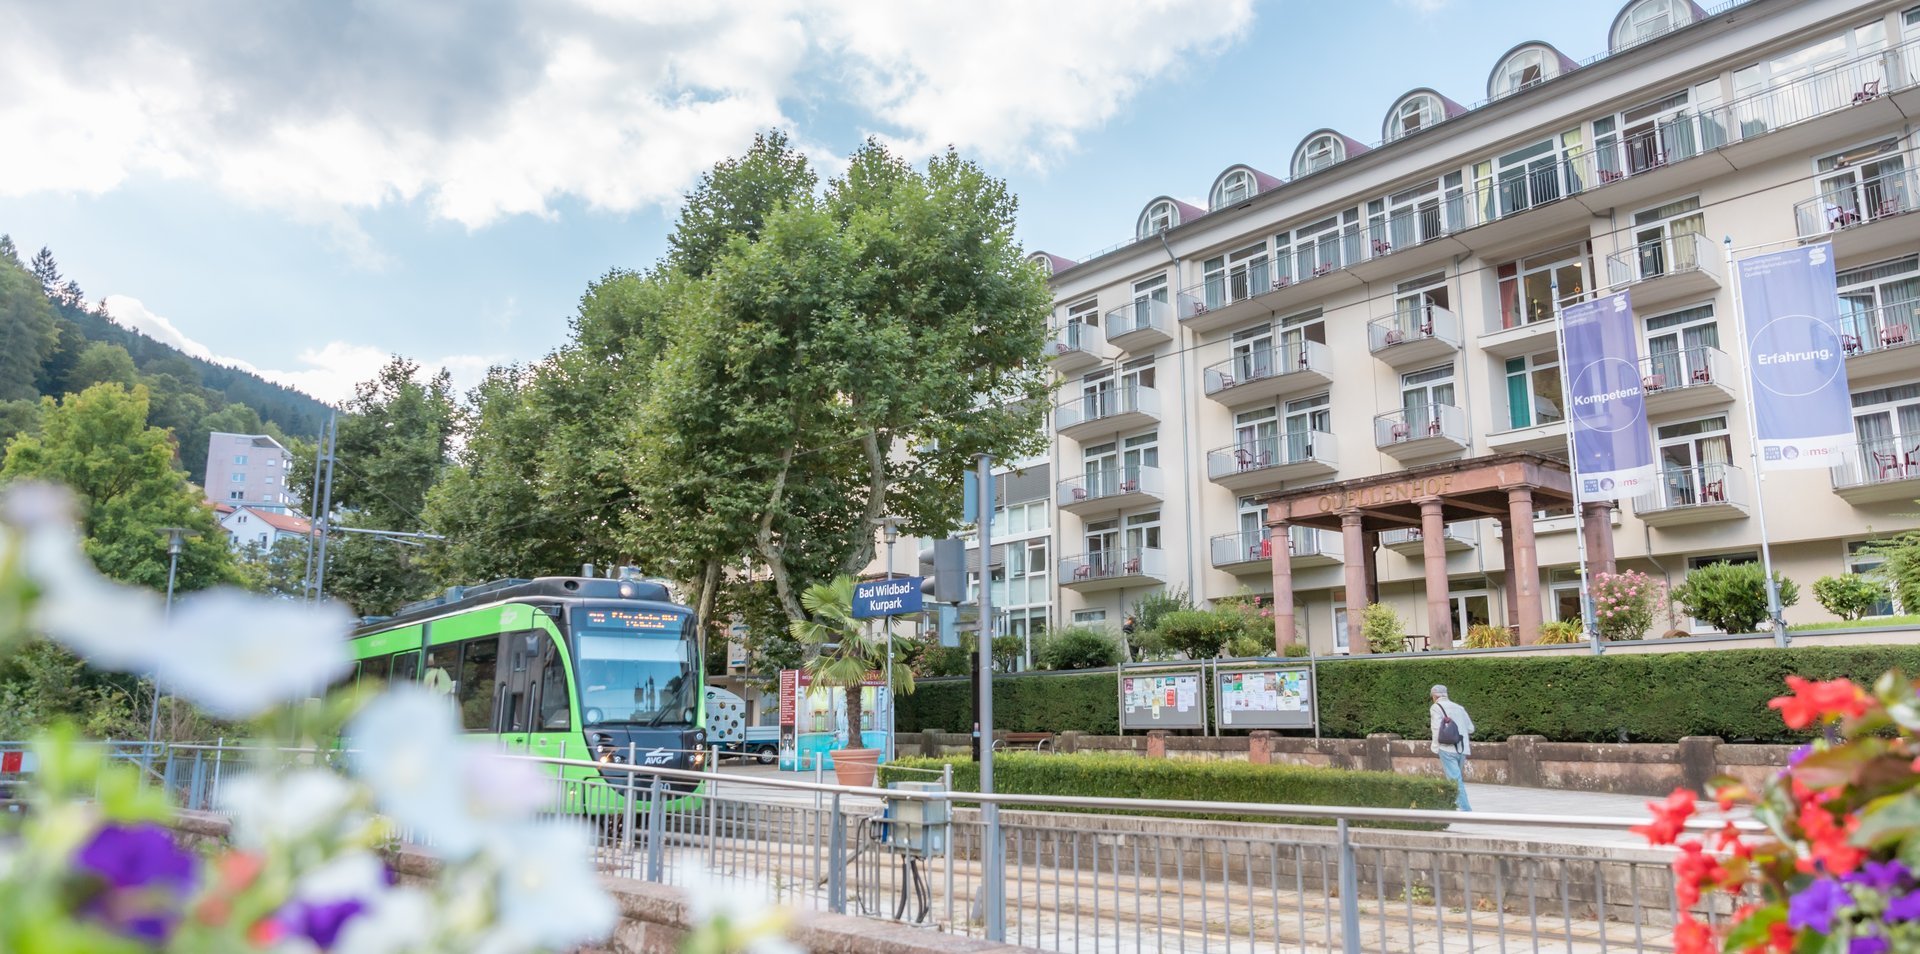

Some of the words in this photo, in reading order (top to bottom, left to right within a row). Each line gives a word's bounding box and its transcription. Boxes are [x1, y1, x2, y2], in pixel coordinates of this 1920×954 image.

[1758, 348, 1833, 366] Erfahrung.
[1574, 385, 1641, 406] Kompetenz.
[1318, 474, 1453, 512] QUELLENHOF
[859, 586, 874, 598] Bad
[876, 581, 914, 597] Wildbad-
[870, 597, 902, 612] Kurpark
[645, 756, 662, 765] AVG
